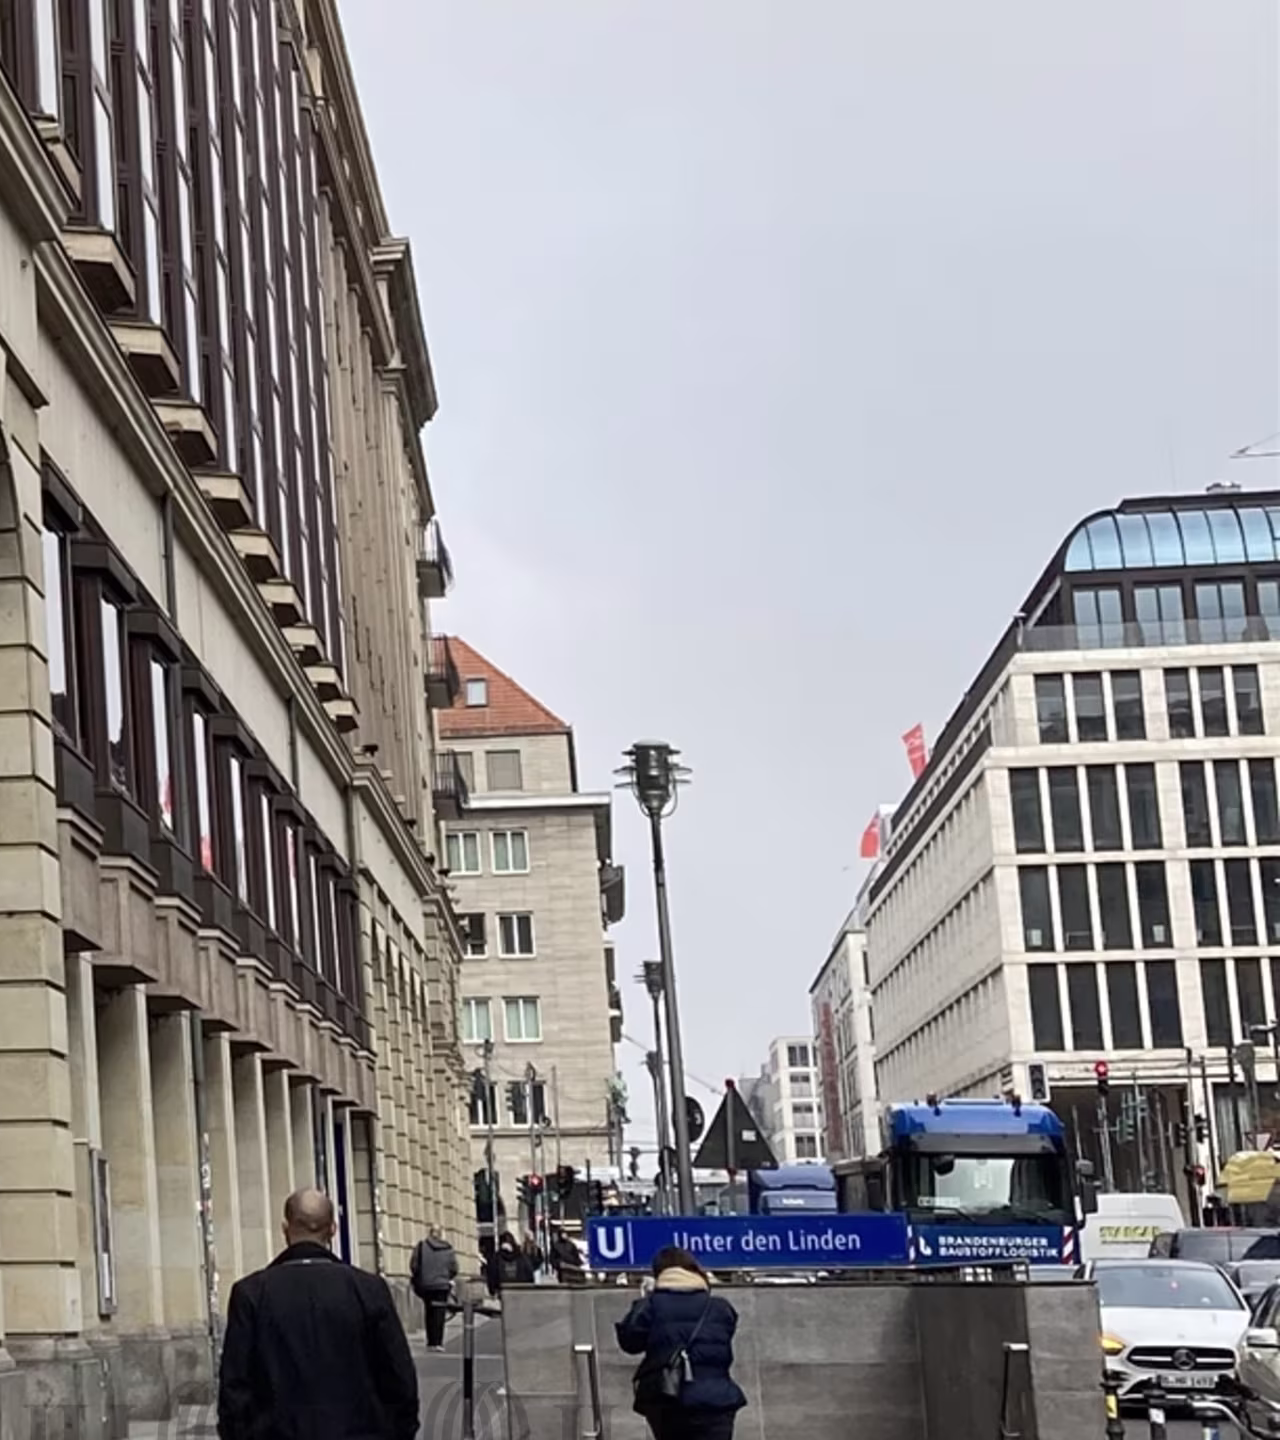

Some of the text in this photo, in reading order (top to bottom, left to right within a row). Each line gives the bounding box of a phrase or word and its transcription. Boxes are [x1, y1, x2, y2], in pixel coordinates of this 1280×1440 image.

[597, 1226, 862, 1259] U Unter den Linden
[938, 1235, 1049, 1247] BRANDENBURGER
[939, 1246, 1059, 1258] BAUSTOFFLOGISTIK
